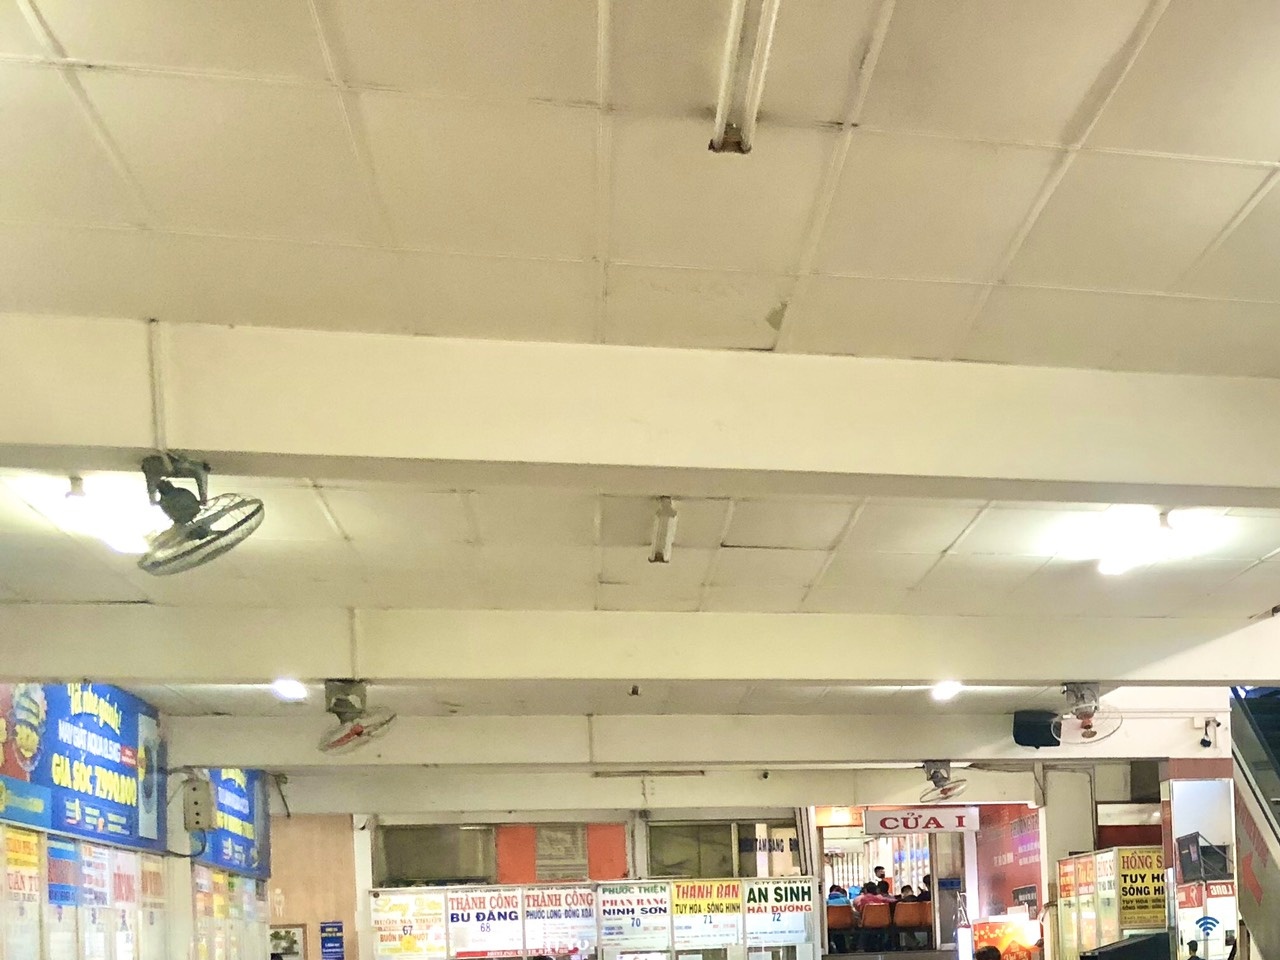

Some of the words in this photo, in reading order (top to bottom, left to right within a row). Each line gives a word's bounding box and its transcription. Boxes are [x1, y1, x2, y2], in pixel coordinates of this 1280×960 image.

[879, 812, 945, 830] CỬA
[1121, 874, 1146, 883] TUY
[525, 892, 561, 908] THÀNH
[565, 891, 594, 908] CÔNG
[747, 887, 769, 904] AN
[774, 886, 811, 902] SINH
[449, 894, 486, 911] THÀNH
[490, 893, 518, 910] CÔNG
[602, 898, 633, 907] PHAN
[637, 897, 667, 906] RANG
[603, 907, 635, 916] NINH
[640, 906, 667, 915] SƠN
[675, 904, 688, 914] TUY
[725, 903, 740, 913] HINH
[703, 915, 713, 924] 71
[772, 912, 781, 922] 72
[480, 923, 490, 933] 68
[631, 918, 641, 928] 70
[402, 925, 413, 935] 67
